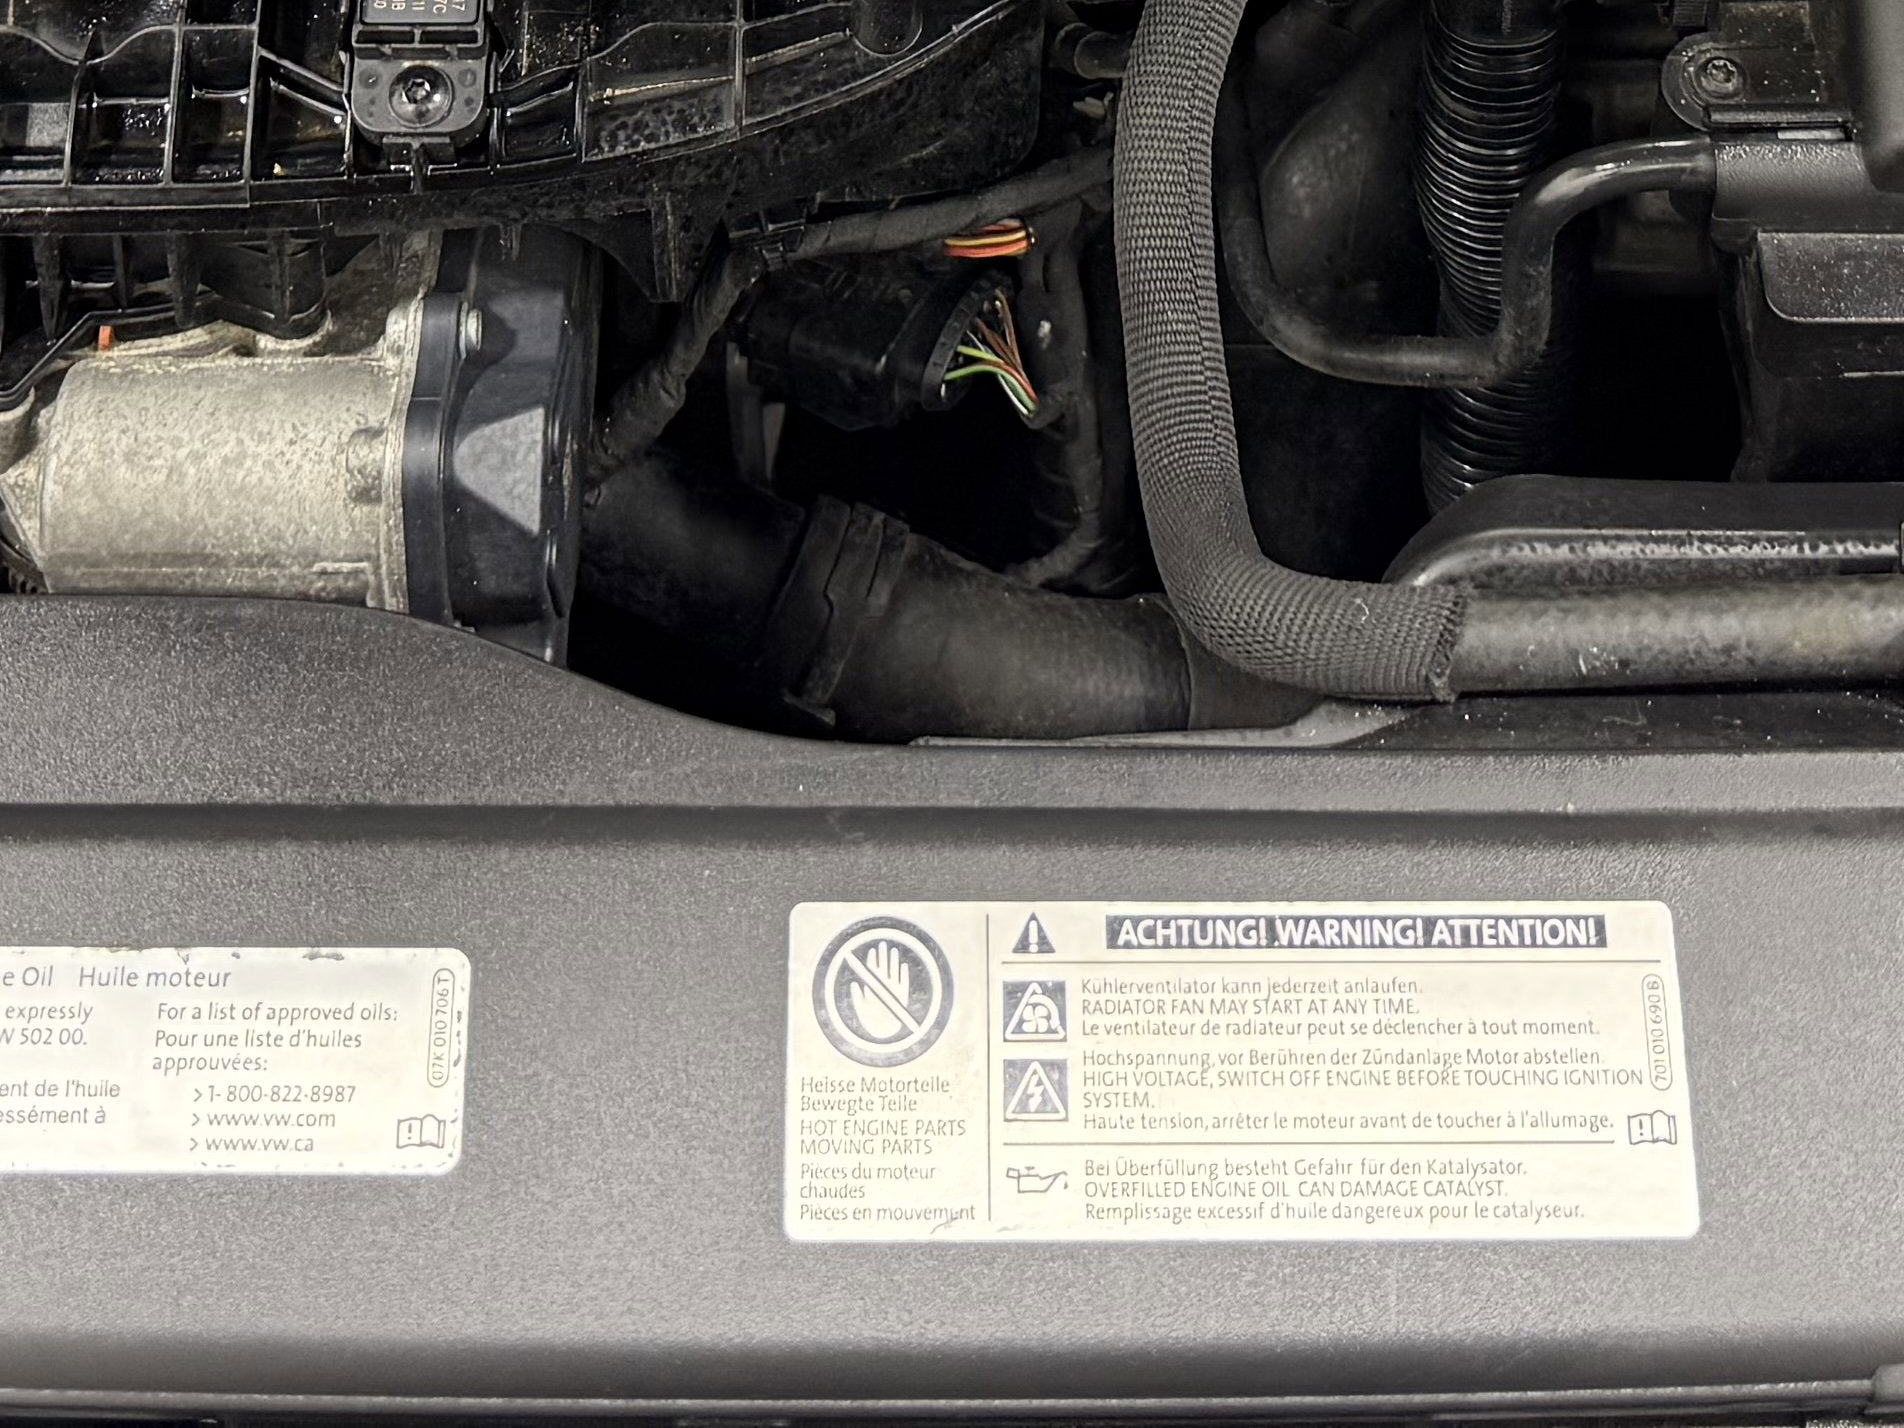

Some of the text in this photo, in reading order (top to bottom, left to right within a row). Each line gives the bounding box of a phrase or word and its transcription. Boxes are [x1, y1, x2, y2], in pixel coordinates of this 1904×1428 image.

[1117, 918, 1597, 946] ACHTUNG! WARNING! ATTENTION!
[23, 965, 53, 987] Oil
[79, 966, 139, 987] Huile
[146, 969, 231, 987] moteur
[1082, 977, 1423, 998] Kühlerventilator kann jederzeit anlaufen.
[5, 1002, 93, 1024] expressly
[158, 1002, 398, 1026] For a list of approved oils:
[1082, 998, 1420, 1014] RADIATOR FAN MAY START AT ANY TIME.
[20, 1028, 52, 1045] 502
[59, 1028, 87, 1045] 00.
[431, 976, 450, 1081] 07K 010 706 T
[1082, 1019, 1599, 1042] Le ventilateur de radiateur peut se déclencher à tout moment.
[1647, 980, 1667, 1082] 701 010 690 B
[156, 1030, 198, 1047] Pour
[204, 1033, 238, 1047] une
[245, 1030, 284, 1048] liste
[152, 1053, 267, 1076] approuvées:
[1218, 1053, 1244, 1066] vor
[1250, 1049, 1326, 1066] Berühren
[1331, 1049, 1356, 1066] der
[1362, 1048, 1462, 1070] Zündanlage
[1466, 1048, 1518, 1064] Motor
[35, 1079, 58, 1097] de
[66, 1079, 120, 1097] l'huile
[801, 1076, 950, 1093] Heisse Motorteile
[1084, 1069, 1643, 1088] HIGH VOLTAGE, SWITCH OFF ENGINE BEFORE TOUCHING IGNITION
[801, 1096, 917, 1116] Bewegte Teile
[1083, 1092, 1155, 1108] SYSTEM.
[95, 1105, 106, 1124] à
[207, 1114, 336, 1127] www.vw.com
[1084, 1110, 1614, 1132] Haute tension, arrêter le moteur avant de toucher à l'allumage.
[801, 1120, 966, 1136] HOT ENGINE PARTS
[206, 1138, 313, 1152] www.vw.ca
[801, 1139, 933, 1155] MOVING PARTS
[801, 1162, 936, 1180] Pièces du moteur
[1085, 1157, 1527, 1180] Bei Überfüllung besteht Gefahr für den Katalysator.
[800, 1183, 865, 1199] chaudes
[1085, 1180, 1508, 1198] OVERFILLED ENGINE OIL CAN DAMAGE CATALYST.
[801, 1204, 847, 1220] Pièces
[853, 1208, 871, 1220] en
[1086, 1200, 1584, 1225] Remplissage excessif d'huile dangereux pour le catalyseur.
